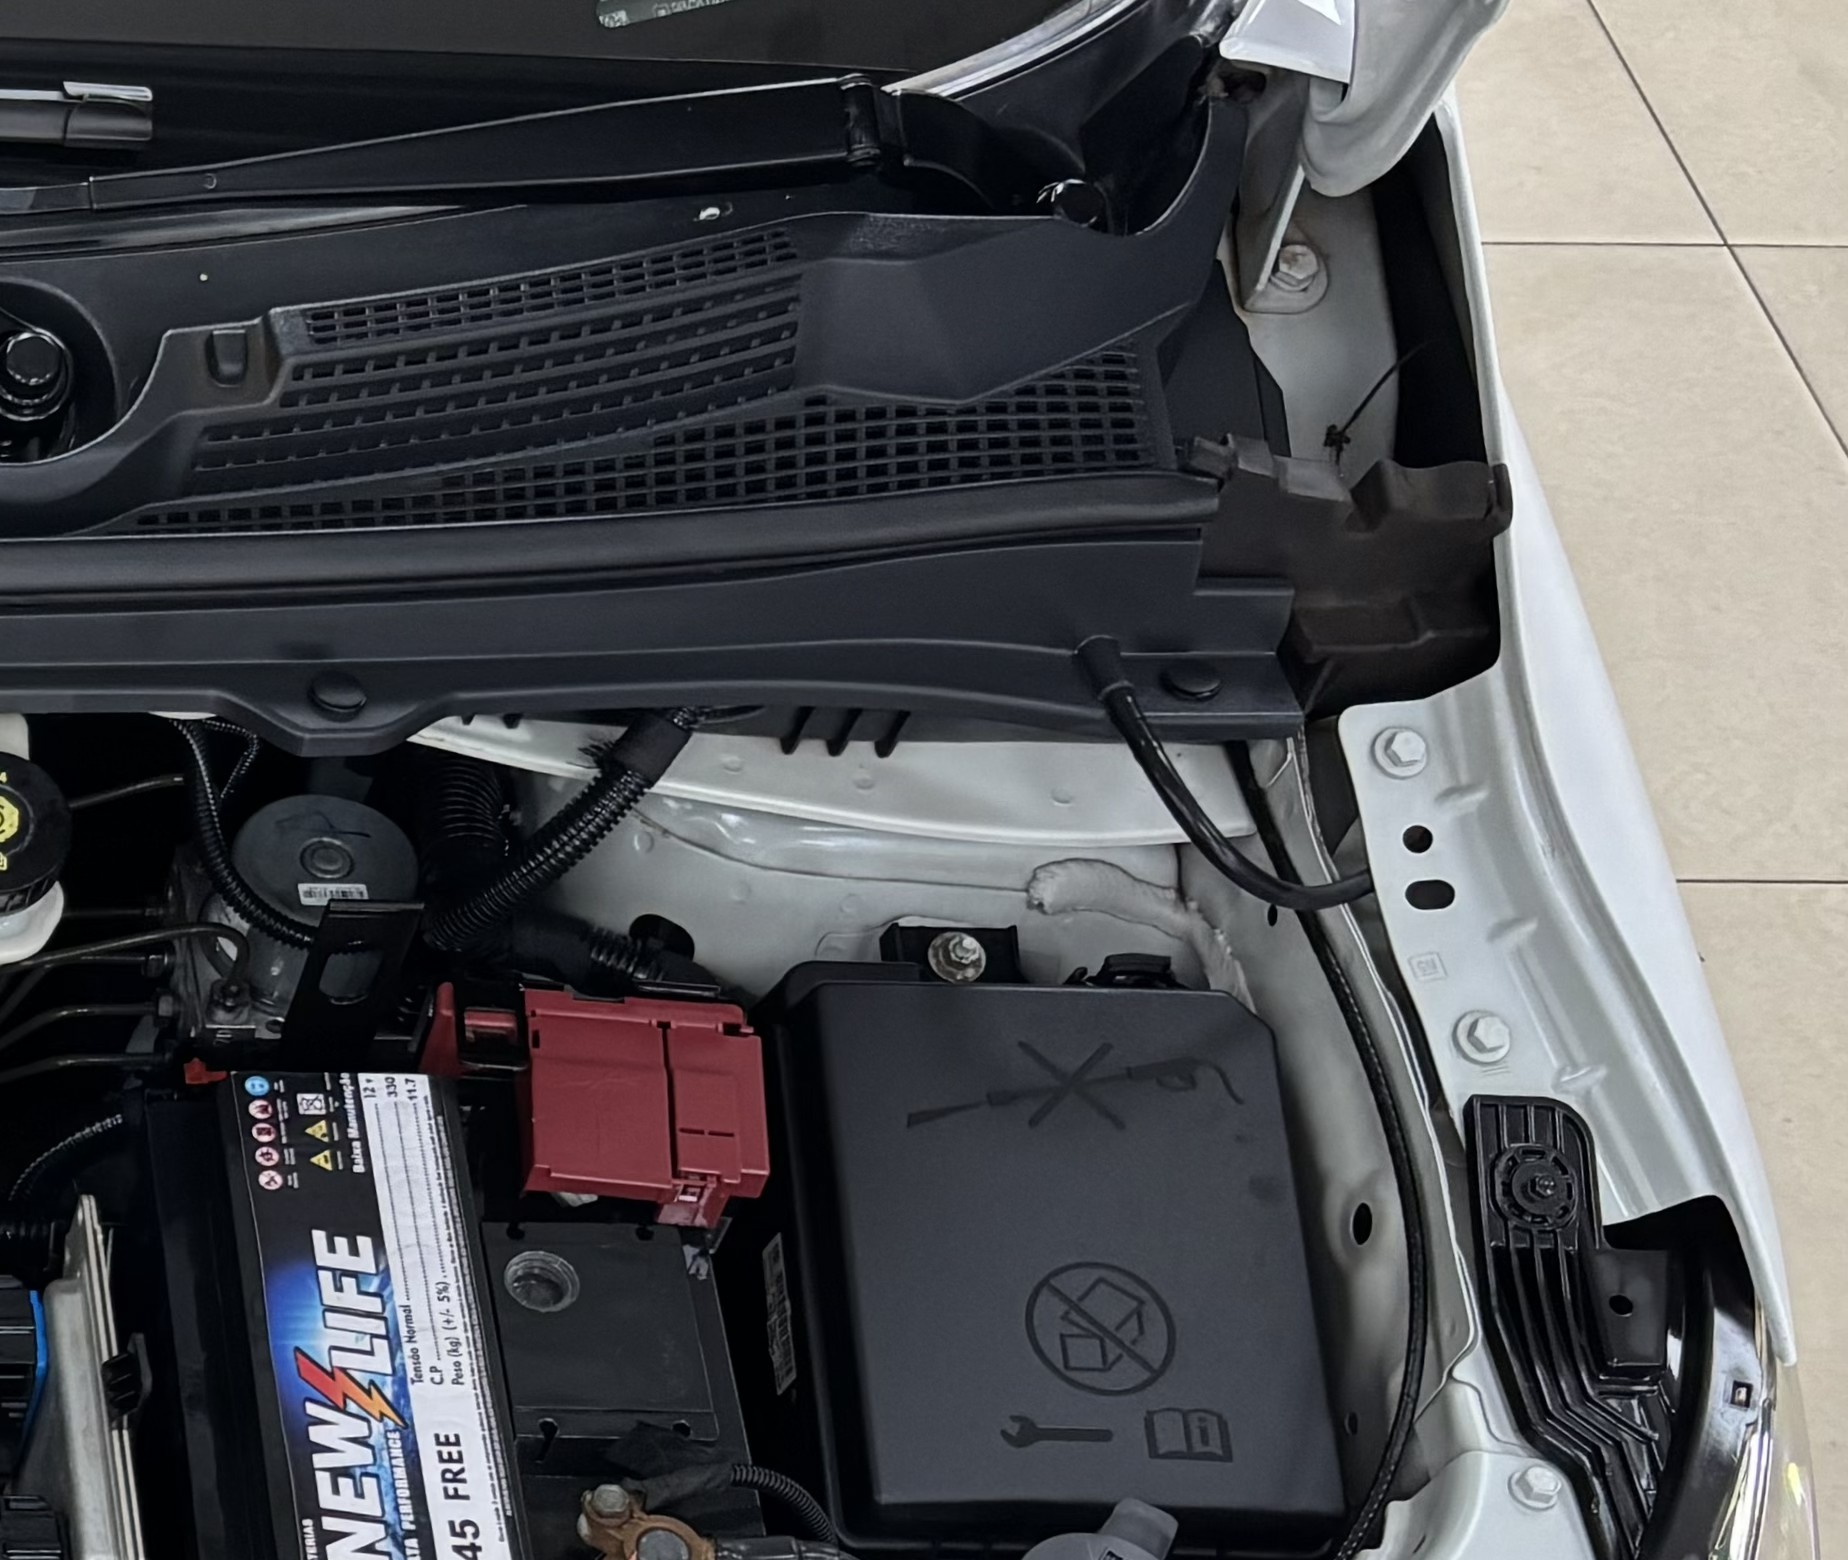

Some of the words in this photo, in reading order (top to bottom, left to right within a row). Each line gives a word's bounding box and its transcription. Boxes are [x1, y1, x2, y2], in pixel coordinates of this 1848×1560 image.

[362, 1087, 377, 1099] 12
[385, 1076, 398, 1098] 330
[404, 1078, 418, 1101] 11.7
[339, 1072, 361, 1138] Manutenção
[350, 1140, 366, 1174] Baixa
[311, 1229, 394, 1375] LIFE
[435, 1281, 451, 1303] 5%)
[399, 1303, 418, 1344] Normal
[445, 1337, 464, 1358] (kg)
[408, 1347, 424, 1385] Tensão
[451, 1360, 465, 1385] Peso
[387, 1430, 416, 1531] PERFORMANCE
[434, 1433, 470, 1501] FREE
